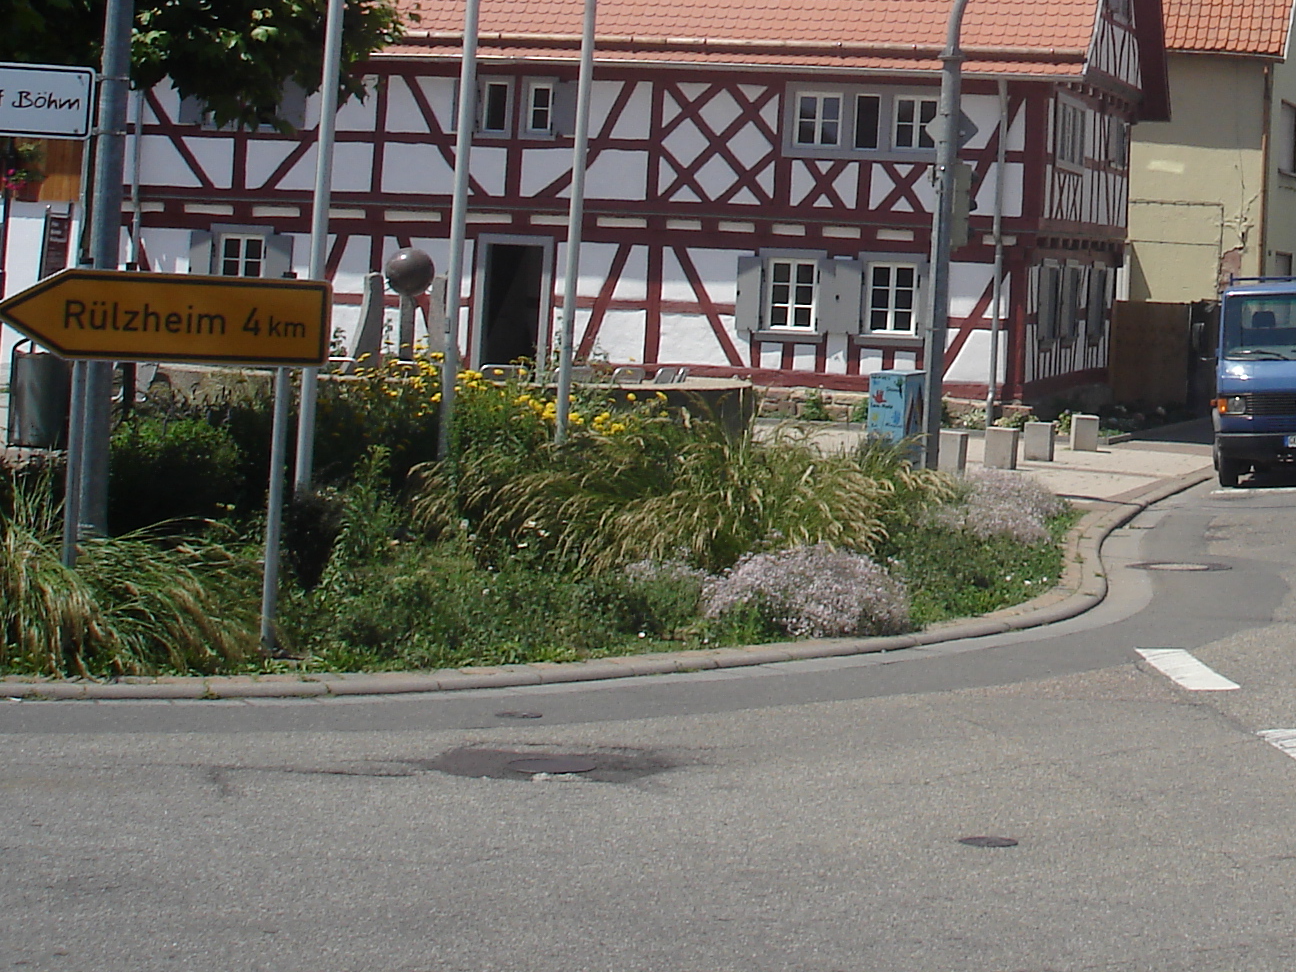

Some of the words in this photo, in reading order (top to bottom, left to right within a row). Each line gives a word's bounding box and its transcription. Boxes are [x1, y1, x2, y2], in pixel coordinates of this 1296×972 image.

[11, 91, 80, 111] Böhm
[64, 299, 226, 335] Rülzheim
[242, 307, 260, 337] 4
[268, 315, 306, 338] km
